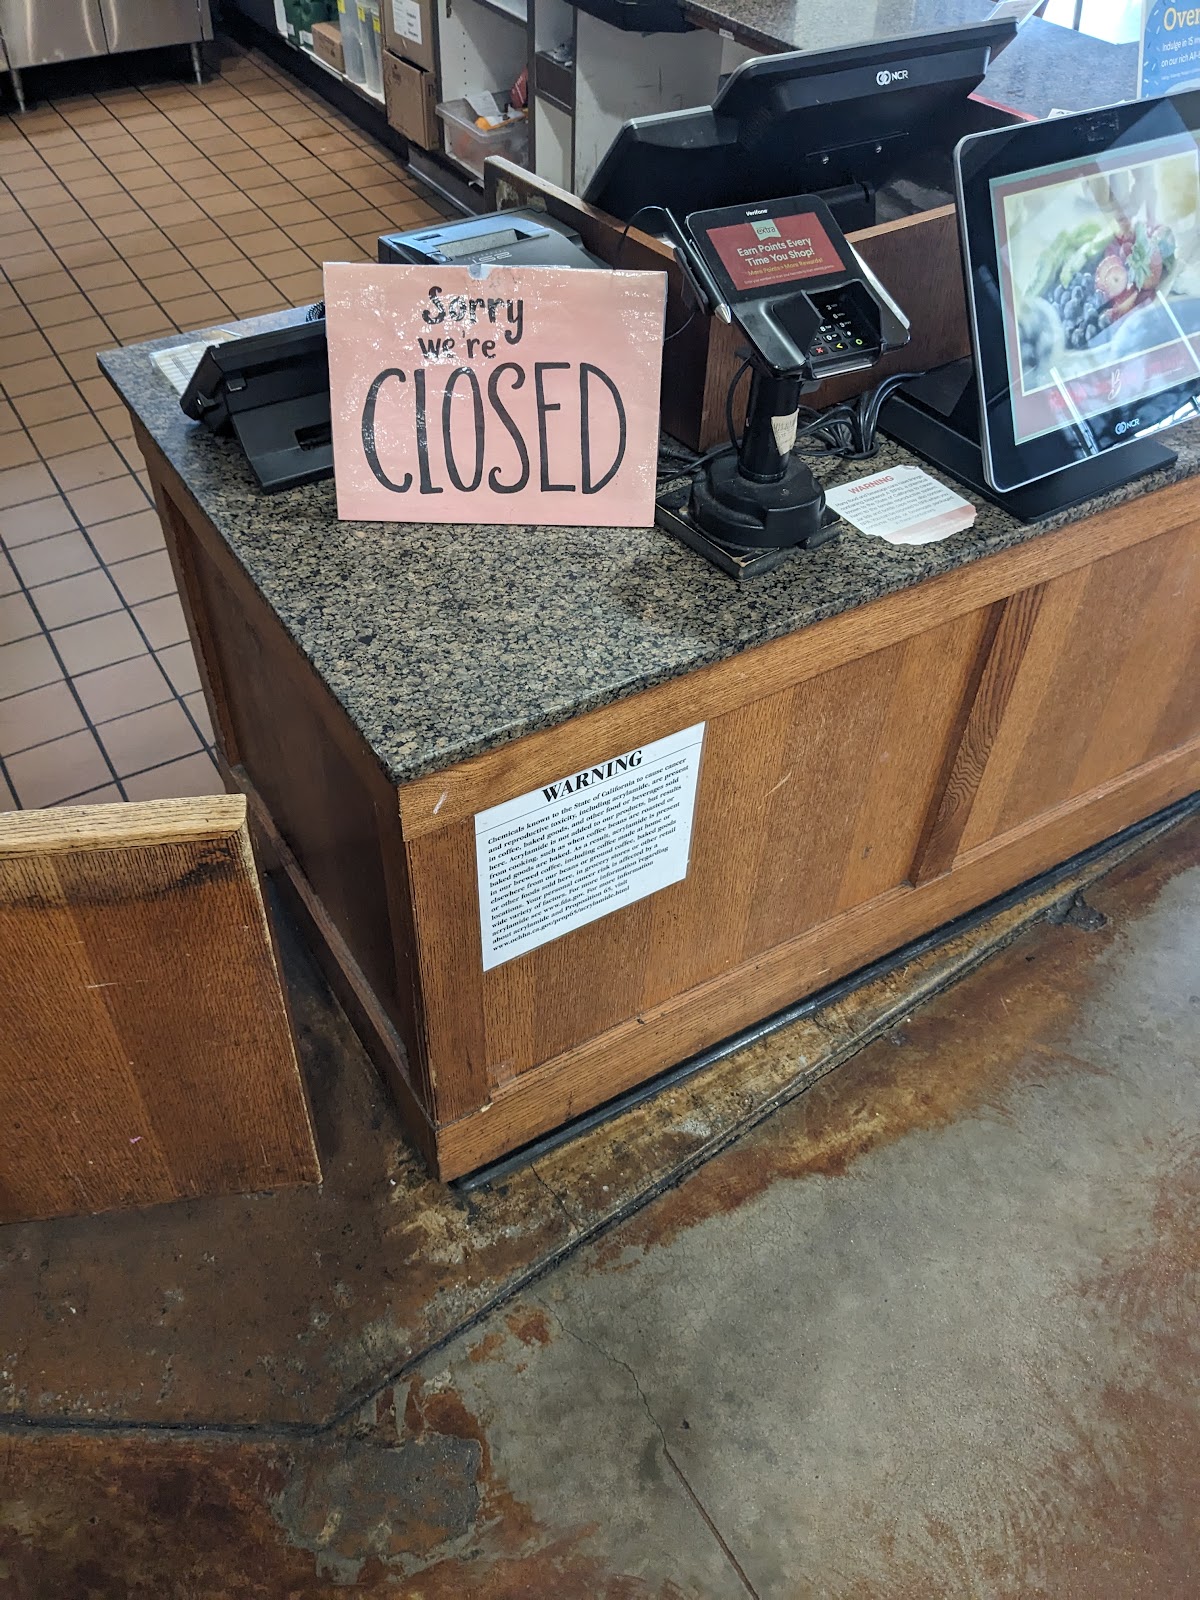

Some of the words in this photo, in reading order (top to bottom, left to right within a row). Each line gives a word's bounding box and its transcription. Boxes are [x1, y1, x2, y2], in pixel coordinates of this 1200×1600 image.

[891, 70, 909, 81] NCR
[737, 245, 758, 257] Earn
[758, 242, 787, 253] Points
[786, 238, 812, 248] Every
[745, 257, 770, 266] Time
[770, 252, 788, 262] You
[788, 247, 815, 258] Shop!
[756, 226, 776, 235] extra
[417, 330, 497, 359] we're
[422, 286, 524, 345] Sorry
[361, 361, 627, 495] CLOSED
[1125, 418, 1140, 428] NCR
[848, 475, 894, 494] WARNING
[488, 826, 524, 844] Chemicals
[526, 816, 550, 829] known
[561, 806, 572, 814] the
[573, 798, 591, 809] State
[592, 792, 600, 801] of
[601, 780, 634, 797] California
[644, 768, 663, 779] cause
[664, 758, 686, 770] cancer
[488, 843, 502, 853] and
[504, 825, 549, 847] reproductive
[550, 814, 577, 827] toxicity,
[579, 799, 610, 815] including
[651, 776, 663, 784] are
[664, 765, 688, 781] present
[542, 750, 643, 803] WARNING
[489, 869, 506, 879] from
[508, 856, 538, 871] cooking,
[540, 847, 555, 858] such
[567, 836, 584, 846] when
[586, 826, 606, 838] coffee
[608, 817, 627, 829] beans
[628, 811, 639, 820] are
[641, 799, 665, 814] roasted
[489, 874, 511, 888] baked
[513, 866, 534, 879] goods
[535, 860, 547, 868] are
[549, 849, 572, 862] baked.
[612, 816, 647, 835] acrylamide
[656, 802, 679, 817] present
[497, 846, 521, 858] coffee,
[523, 834, 545, 847] baked
[546, 826, 569, 839] goods,
[571, 817, 584, 828] and
[586, 810, 604, 821] other
[606, 802, 621, 813] food
[632, 785, 663, 801] beverages
[665, 776, 679, 787] sold
[509, 843, 548, 862] Acrylamide
[558, 833, 569, 842] not
[571, 823, 592, 836] added
[602, 814, 614, 823] our
[647, 794, 658, 803] but
[659, 785, 681, 798] results
[490, 886, 525, 904] elsewhere
[526, 878, 543, 889] from
[545, 872, 557, 880] our
[559, 863, 578, 874] beans
[589, 847, 613, 862] ground
[614, 839, 635, 850] coffee,
[637, 827, 656, 840] baked
[657, 820, 676, 832] goods
[491, 918, 507, 928] wide
[509, 907, 532, 919] variety
[533, 901, 541, 909] of
[568, 886, 580, 894] For
[581, 878, 598, 888] more
[599, 861, 636, 880] information
[638, 846, 668, 863] regarding
[499, 883, 512, 892] our
[513, 871, 538, 886] brewed
[540, 863, 562, 874] coffee,
[564, 848, 595, 864] including
[596, 838, 616, 850] coffee
[617, 830, 635, 841] made
[644, 818, 662, 829] home
[500, 896, 519, 908] other
[521, 888, 540, 899] foods
[541, 880, 555, 890] sold
[557, 874, 574, 883] here,
[584, 857, 609, 873] grocery
[610, 848, 630, 860] stores
[640, 836, 657, 846] other
[659, 826, 676, 838] retail
[526, 895, 542, 905] Your
[543, 880, 572, 899] personal
[574, 871, 596, 883] cancer
[597, 864, 610, 873] risk
[618, 848, 643, 864] affected
[492, 917, 529, 936] acrylamide
[530, 911, 542, 919] see
[586, 885, 597, 893] For
[599, 878, 615, 888] more
[617, 861, 653, 880] information
[492, 931, 511, 944] about
[513, 915, 549, 934] acrylamide
[551, 907, 563, 917] and
[565, 891, 601, 911] Proposition
[614, 879, 627, 888] visit
